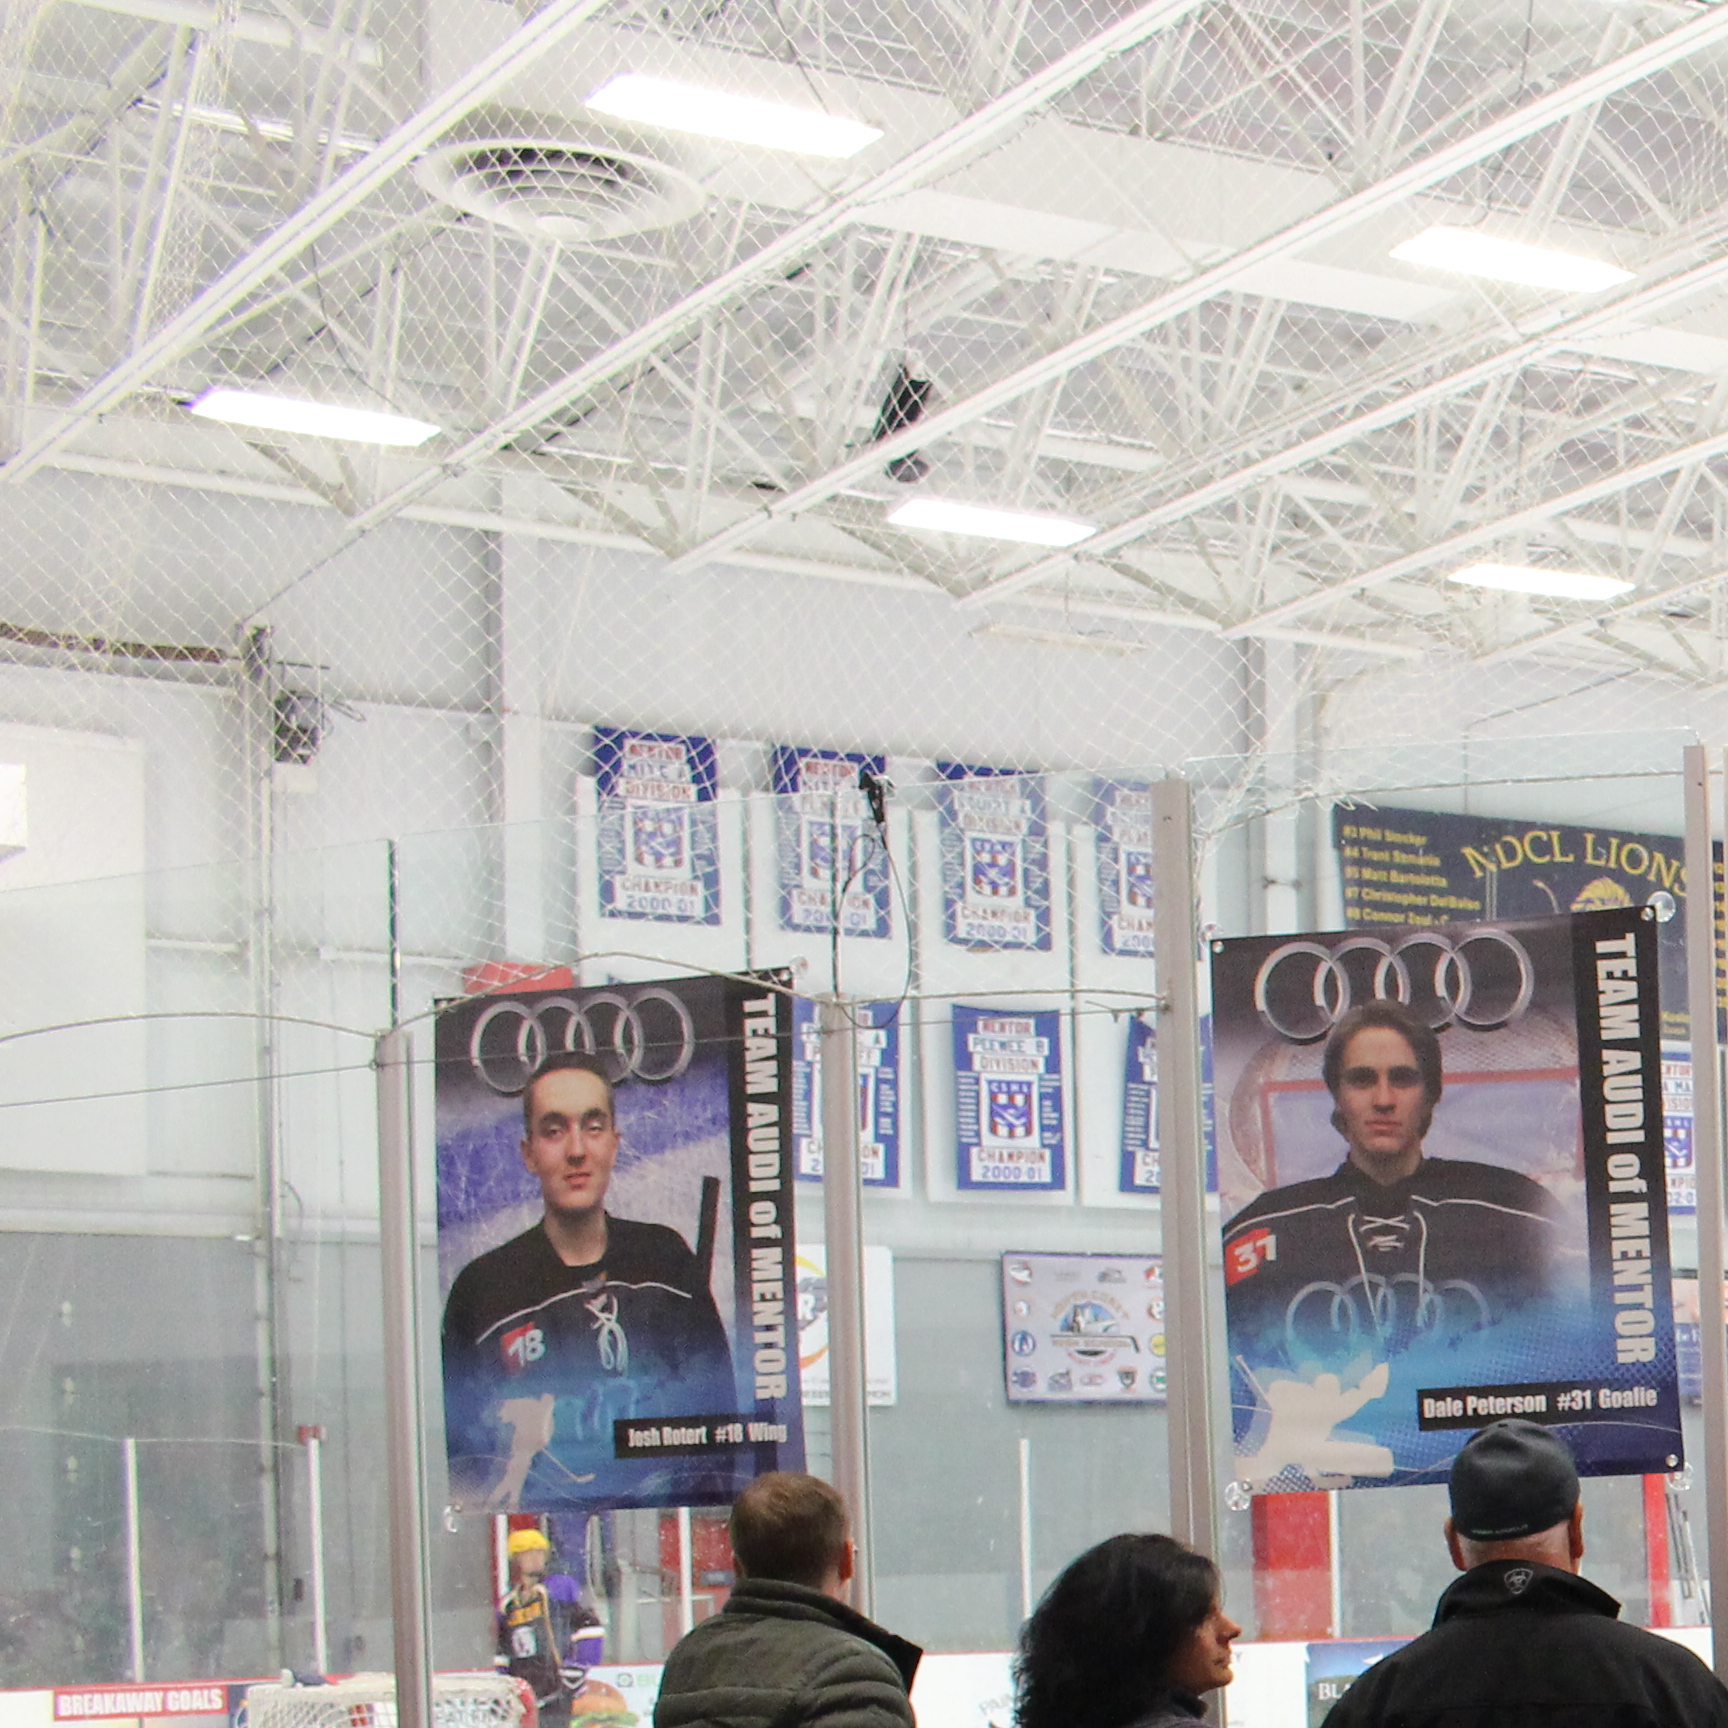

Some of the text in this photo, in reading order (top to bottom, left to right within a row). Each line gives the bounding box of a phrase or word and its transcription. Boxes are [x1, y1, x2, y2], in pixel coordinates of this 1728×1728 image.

[1460, 831, 1575, 878] NDCL
[982, 1018, 1033, 1036] MENTOR
[979, 1055, 1040, 1072] DIVISION
[977, 1149, 1047, 1166] CHAMPION
[1595, 933, 1657, 1364] TEAM AUDI of MENTOR
[742, 997, 788, 1401] TEAM AUDI of MENTOR
[1233, 1235, 1278, 1273] 31
[506, 1329, 547, 1367] 18
[1422, 1387, 1658, 1419] Dale Peterson #31 Goalie
[628, 1426, 662, 1449] Josh
[748, 1422, 788, 1444] Wing
[58, 1688, 224, 1717] BREAKAWAY GOALS
